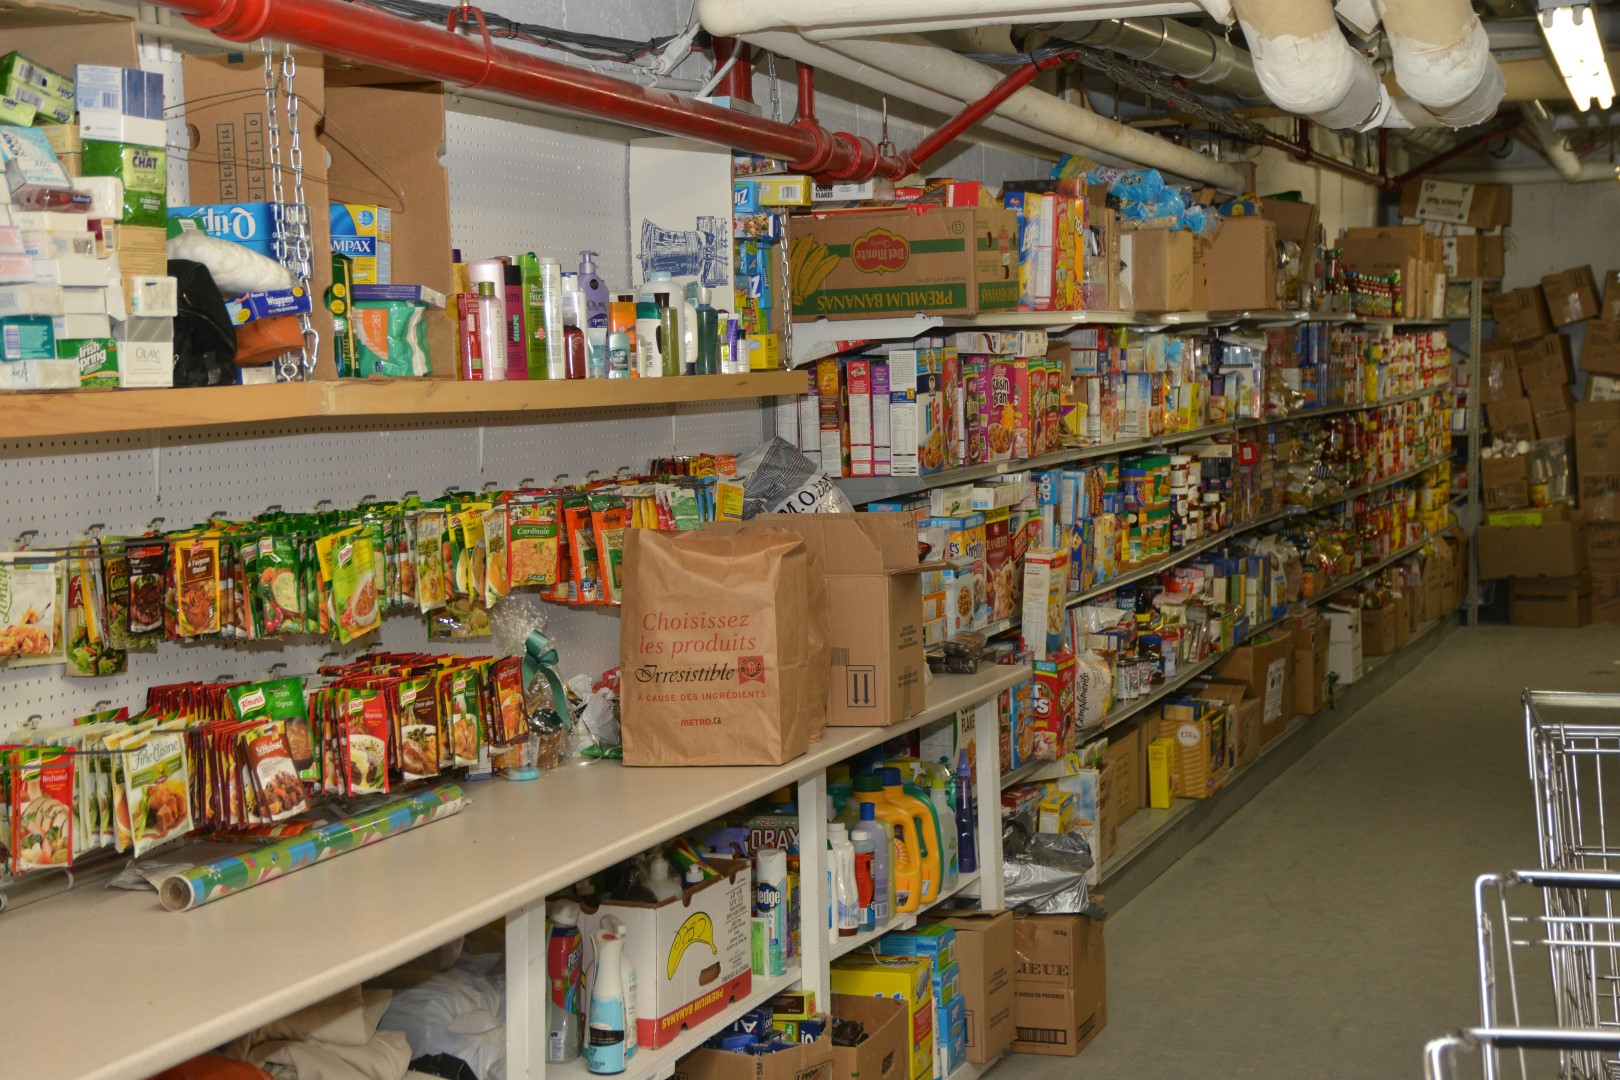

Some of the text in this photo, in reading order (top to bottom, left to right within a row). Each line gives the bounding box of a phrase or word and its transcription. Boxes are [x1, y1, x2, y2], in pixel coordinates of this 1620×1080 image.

[132, 156, 158, 169] CHAT
[815, 184, 833, 192] CORN
[204, 207, 256, 240] Q-tip
[331, 239, 371, 253] MPAX
[856, 248, 905, 262] Del Monte
[817, 289, 954, 311] PREMIUM BANANAS
[79, 341, 100, 356] Irish
[136, 347, 159, 359] OLAY
[80, 349, 107, 371] pring
[991, 376, 1010, 393] Raisin
[925, 397, 941, 435] life
[192, 565, 207, 574] Onion
[643, 611, 750, 631] Choisissez
[639, 633, 756, 660] les produits
[634, 663, 735, 684] Irresistible
[274, 690, 290, 698] Onion
[637, 689, 767, 702] À CAUSE DES INGRÉDIENTS
[240, 695, 264, 710] Knorr
[275, 700, 294, 708] Oignon
[132, 740, 178, 771] Fine Cuisine
[758, 888, 781, 909] ledge
[661, 989, 724, 1029] PREMIUM BANANAS
